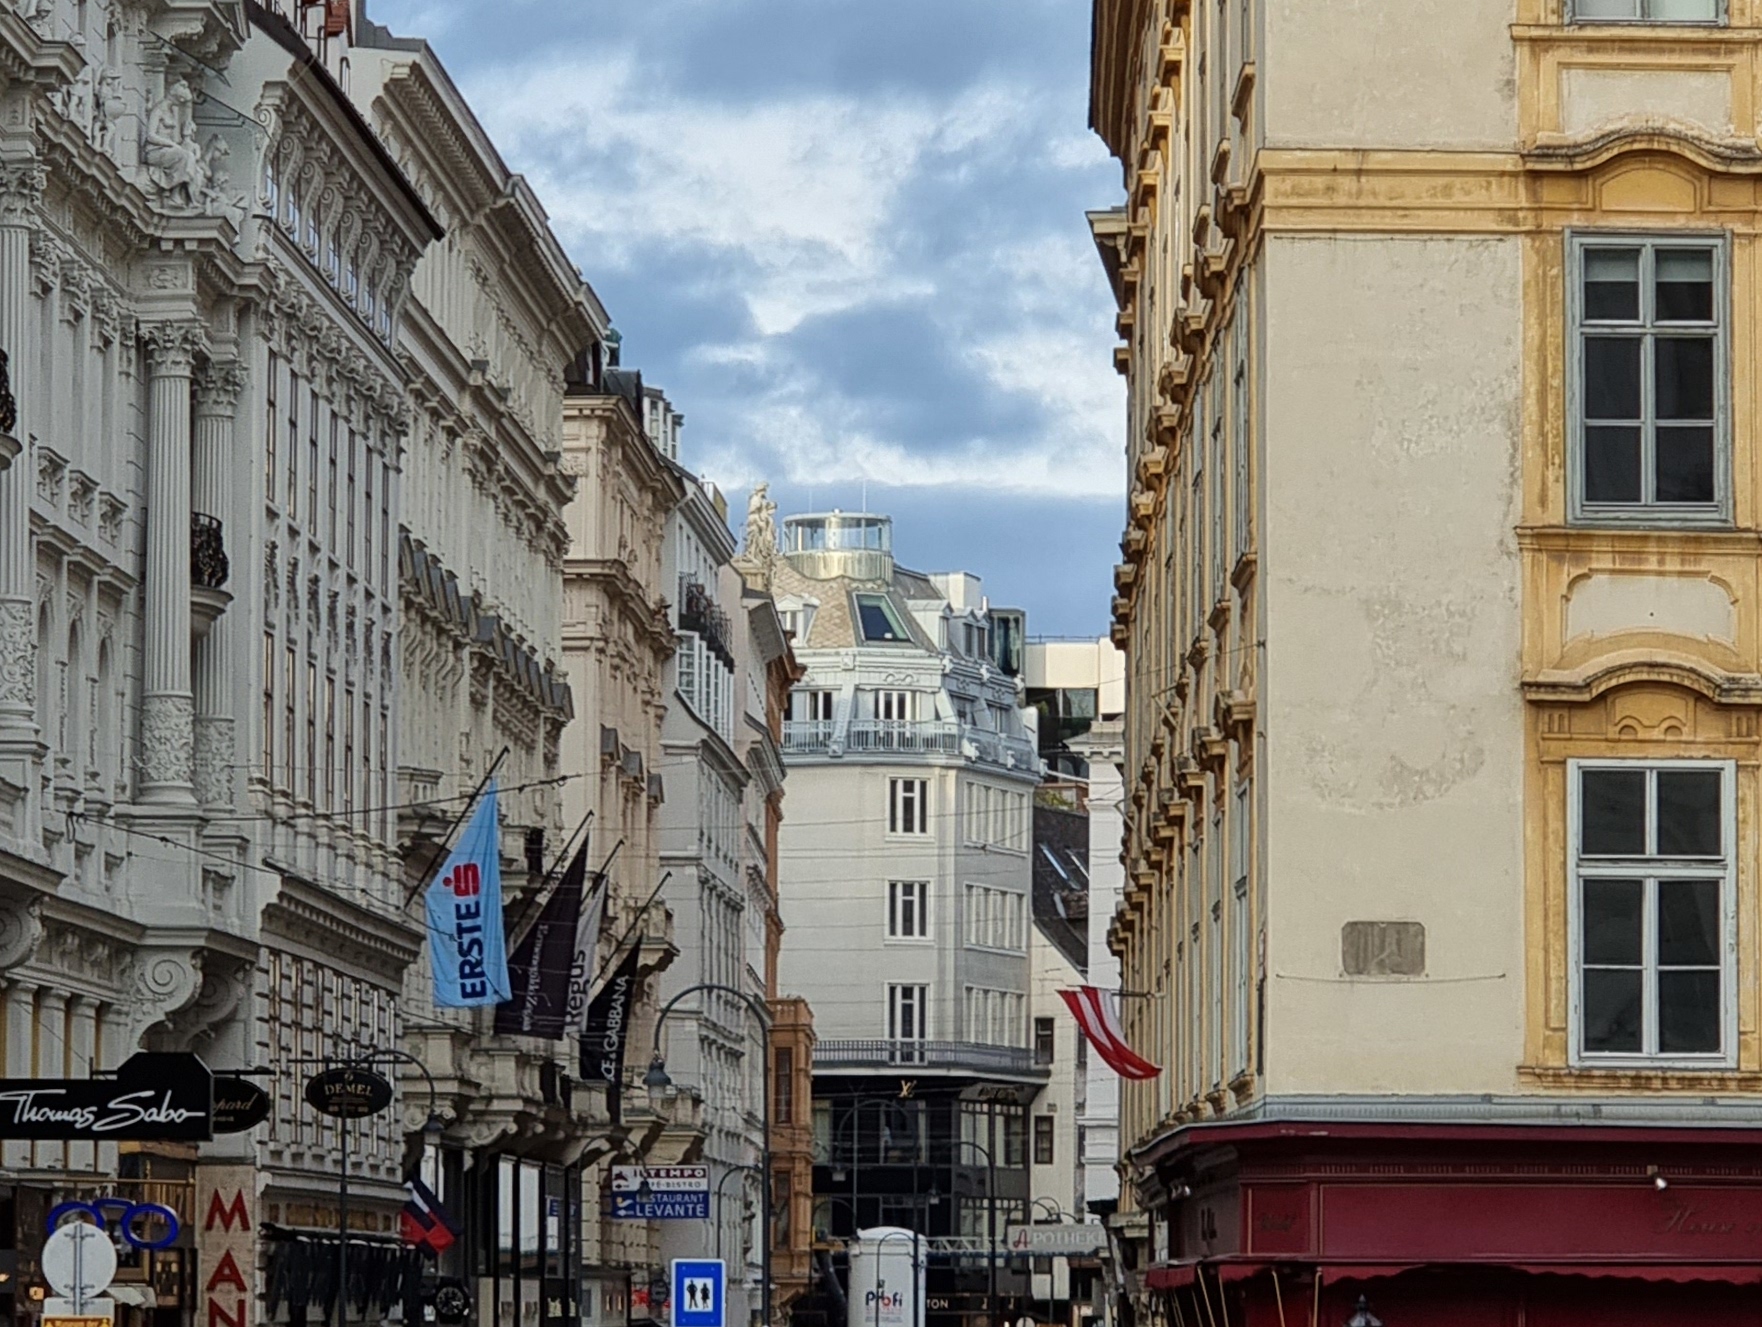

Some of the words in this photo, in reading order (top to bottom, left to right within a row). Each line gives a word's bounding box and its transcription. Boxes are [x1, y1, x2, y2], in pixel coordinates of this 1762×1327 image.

[455, 901, 487, 999] ERSTE
[565, 949, 591, 1026] Regus
[603, 974, 630, 1052] GABBANA
[0, 1088, 98, 1129] Thomas
[91, 1089, 206, 1131] Sabo
[214, 1092, 259, 1114] pard
[648, 1168, 705, 1178] TEMPO
[636, 1193, 705, 1203] STAURANT
[636, 1203, 705, 1217] LEVANTE
